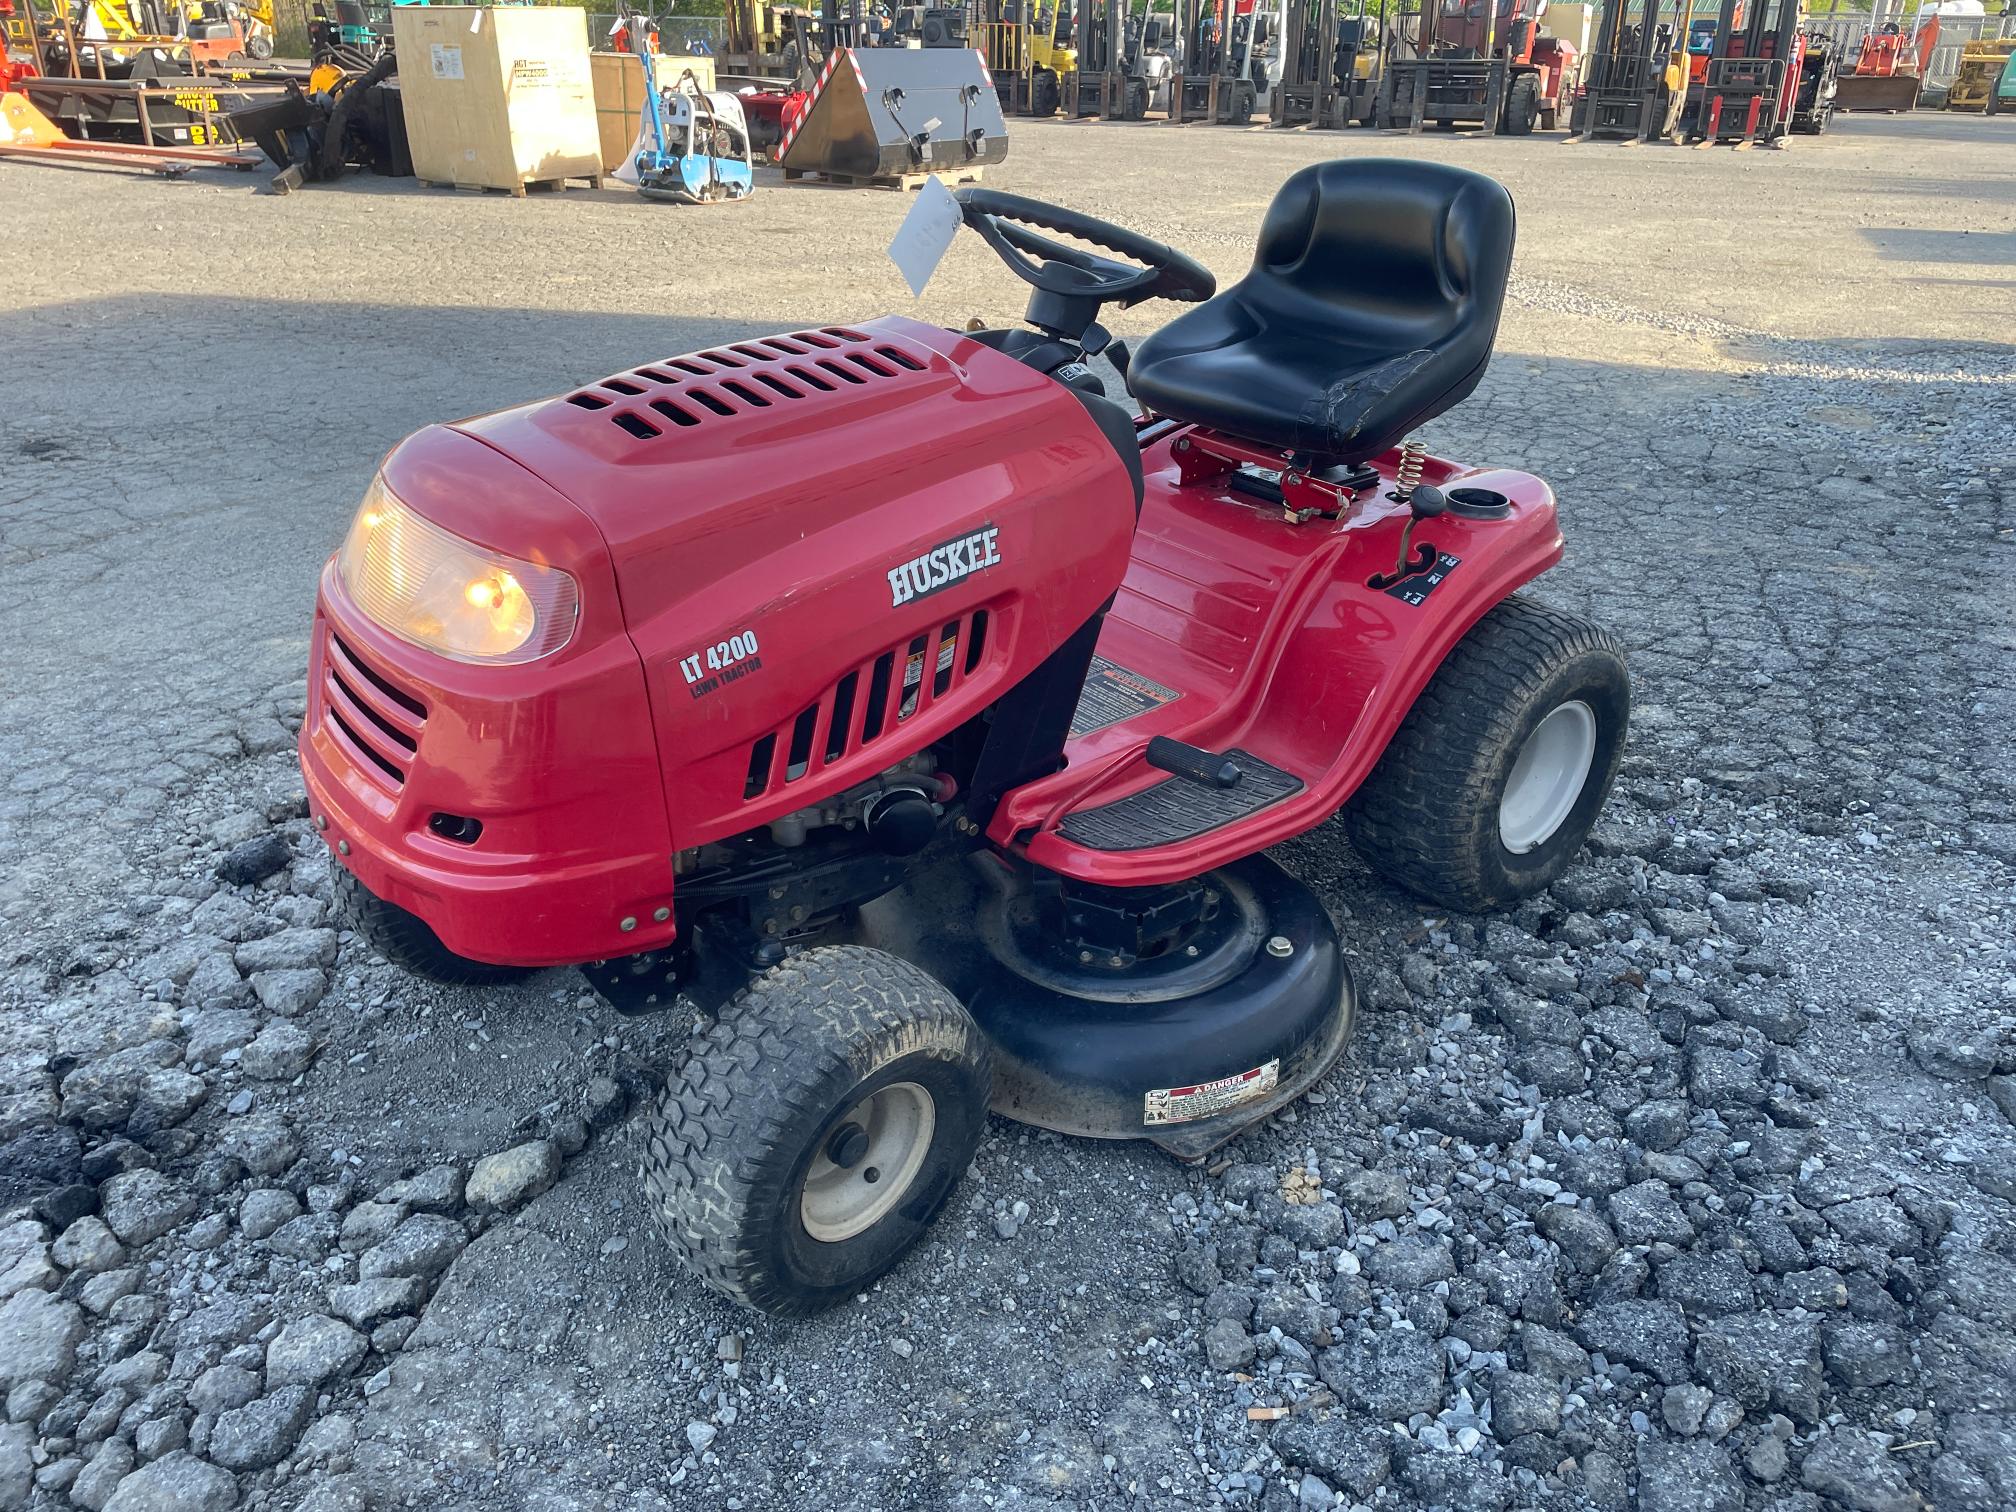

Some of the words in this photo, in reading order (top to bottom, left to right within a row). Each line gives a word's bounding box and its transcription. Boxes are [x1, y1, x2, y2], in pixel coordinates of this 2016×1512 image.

[887, 527, 1002, 607] HUSKEE
[1427, 575, 1441, 585] N
[680, 652, 705, 684] LT
[707, 631, 758, 671] 4200
[690, 674, 719, 700] LAWN
[717, 657, 763, 684] TRACTOR
[1204, 1075, 1244, 1091] DANGER
